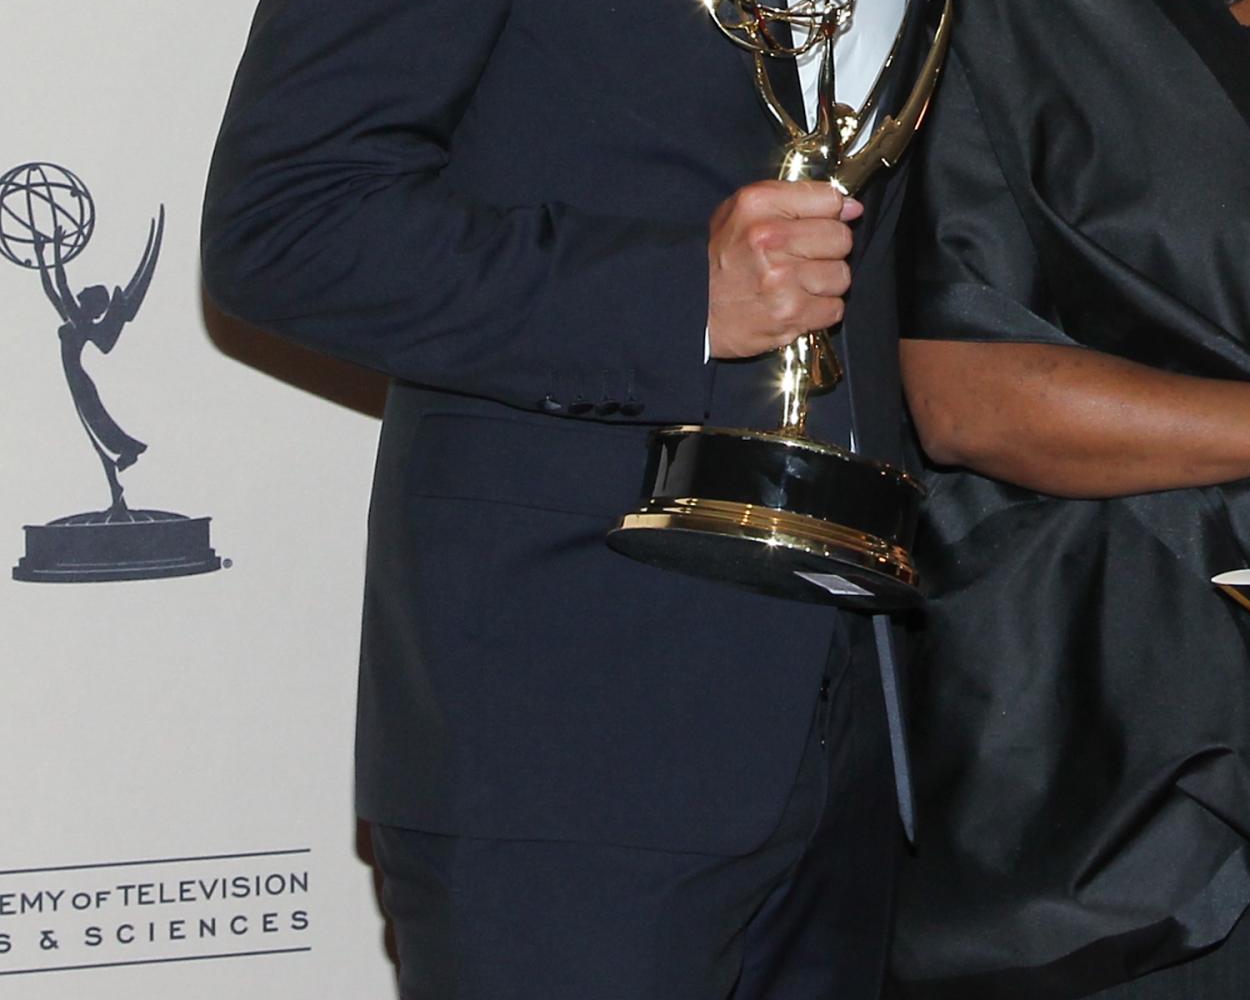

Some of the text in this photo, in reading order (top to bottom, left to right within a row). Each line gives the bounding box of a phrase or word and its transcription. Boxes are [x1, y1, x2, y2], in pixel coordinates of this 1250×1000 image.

[71, 891, 111, 910] OF
[116, 871, 308, 906] TELEVISION
[40, 930, 59, 950] &
[84, 910, 309, 946] SCIENCES
